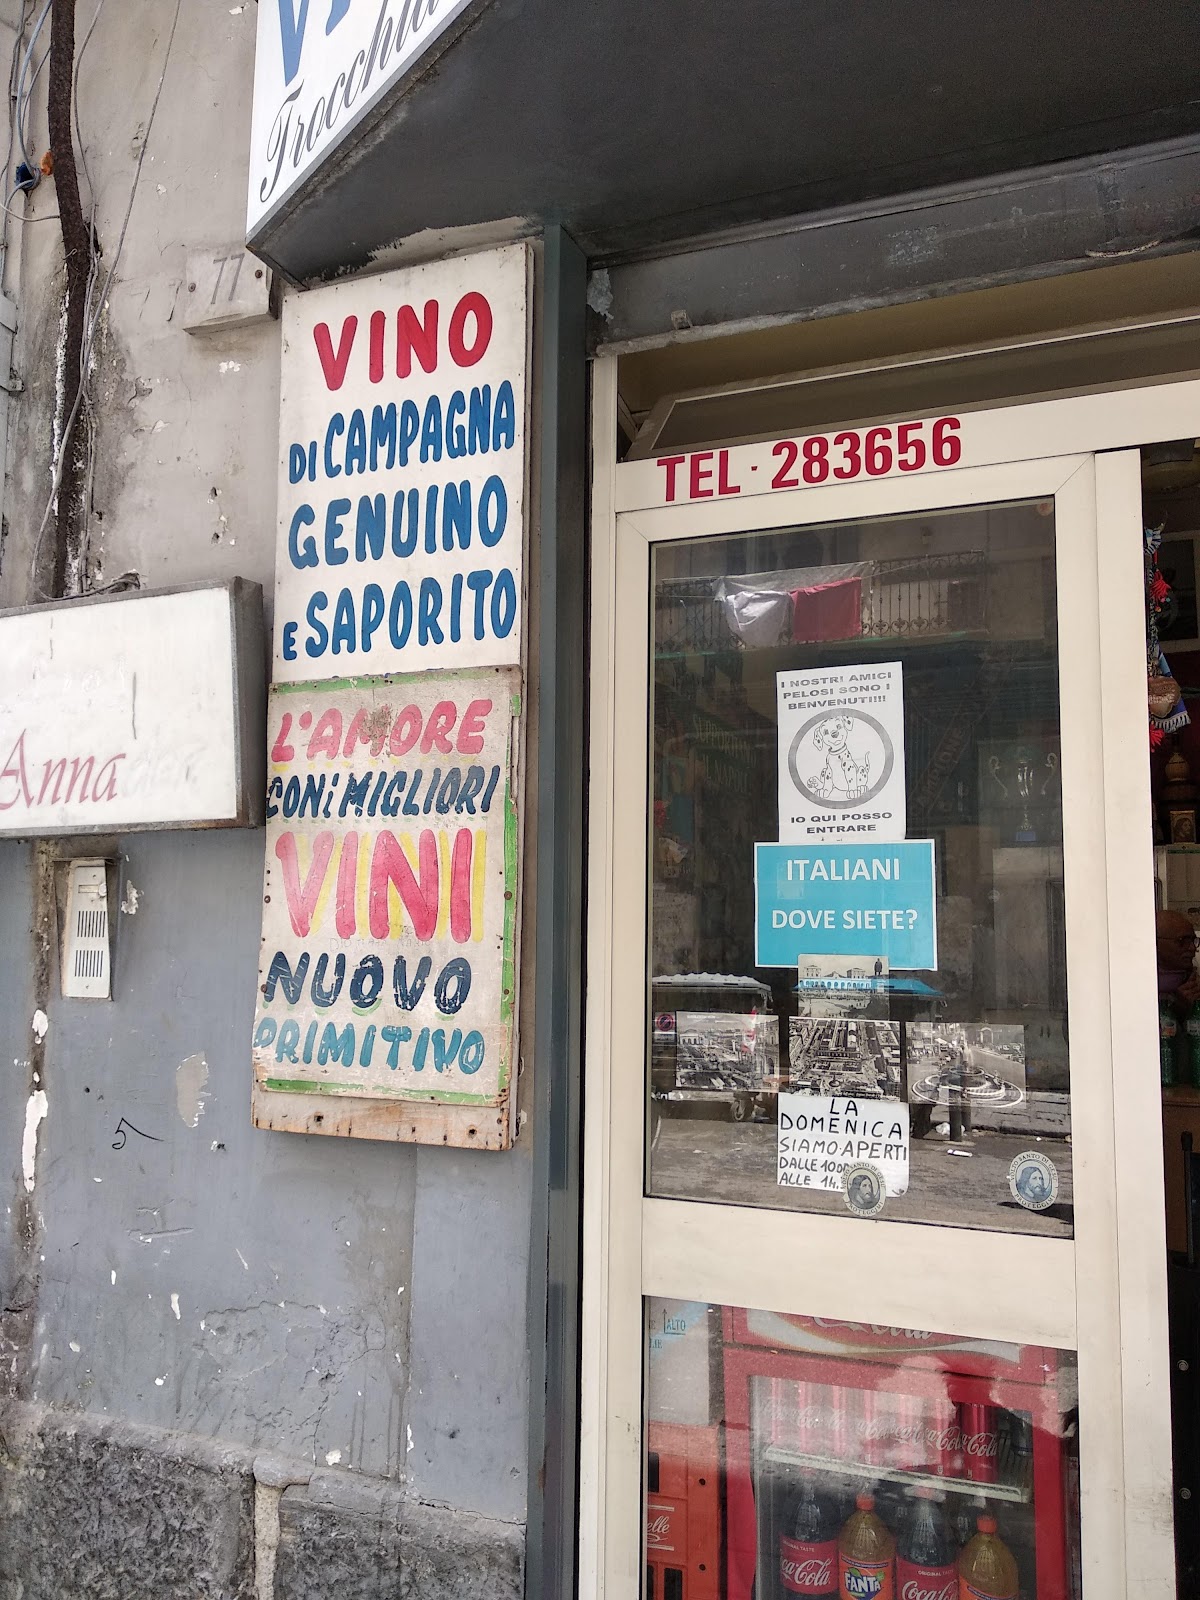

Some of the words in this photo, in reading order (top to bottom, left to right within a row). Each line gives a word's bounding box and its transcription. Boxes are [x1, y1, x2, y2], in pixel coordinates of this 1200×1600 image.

[211, 252, 245, 304] 77
[313, 291, 493, 391] VINO
[289, 441, 317, 484] DI
[324, 380, 516, 478] CAMPAGNA
[771, 417, 961, 489] 283656
[288, 475, 508, 570] GENUINO
[282, 621, 298, 661] E
[305, 568, 517, 658] SAPORITO
[783, 688, 834, 699] PELOSI
[839, 684, 881, 694] SONO
[790, 675, 844, 688] NOSTRI
[848, 671, 892, 683] AMICI
[271, 699, 493, 763] L'AMORE
[0, 728, 127, 810] Anna
[806, 824, 876, 834] ENTRARE
[810, 814, 837, 823] QUI
[841, 812, 893, 821] POSSO
[787, 858, 900, 881] ITALIANI
[275, 828, 474, 942] VINI
[772, 910, 836, 929] DOVE
[842, 909, 918, 930] SIETE?
[263, 951, 472, 1015] NUOVO
[252, 1016, 485, 1075] PRIMITIVO
[829, 1098, 858, 1116] LA
[780, 1112, 902, 1140] DOMENICA
[779, 1136, 838, 1155] SIAMO
[841, 1141, 907, 1161] APERTI
[779, 1156, 818, 1172] DALLE
[779, 1171, 811, 1186] ALLE
[666, 1319, 686, 1332] ALTO
[844, 1570, 881, 1593] FANTA
